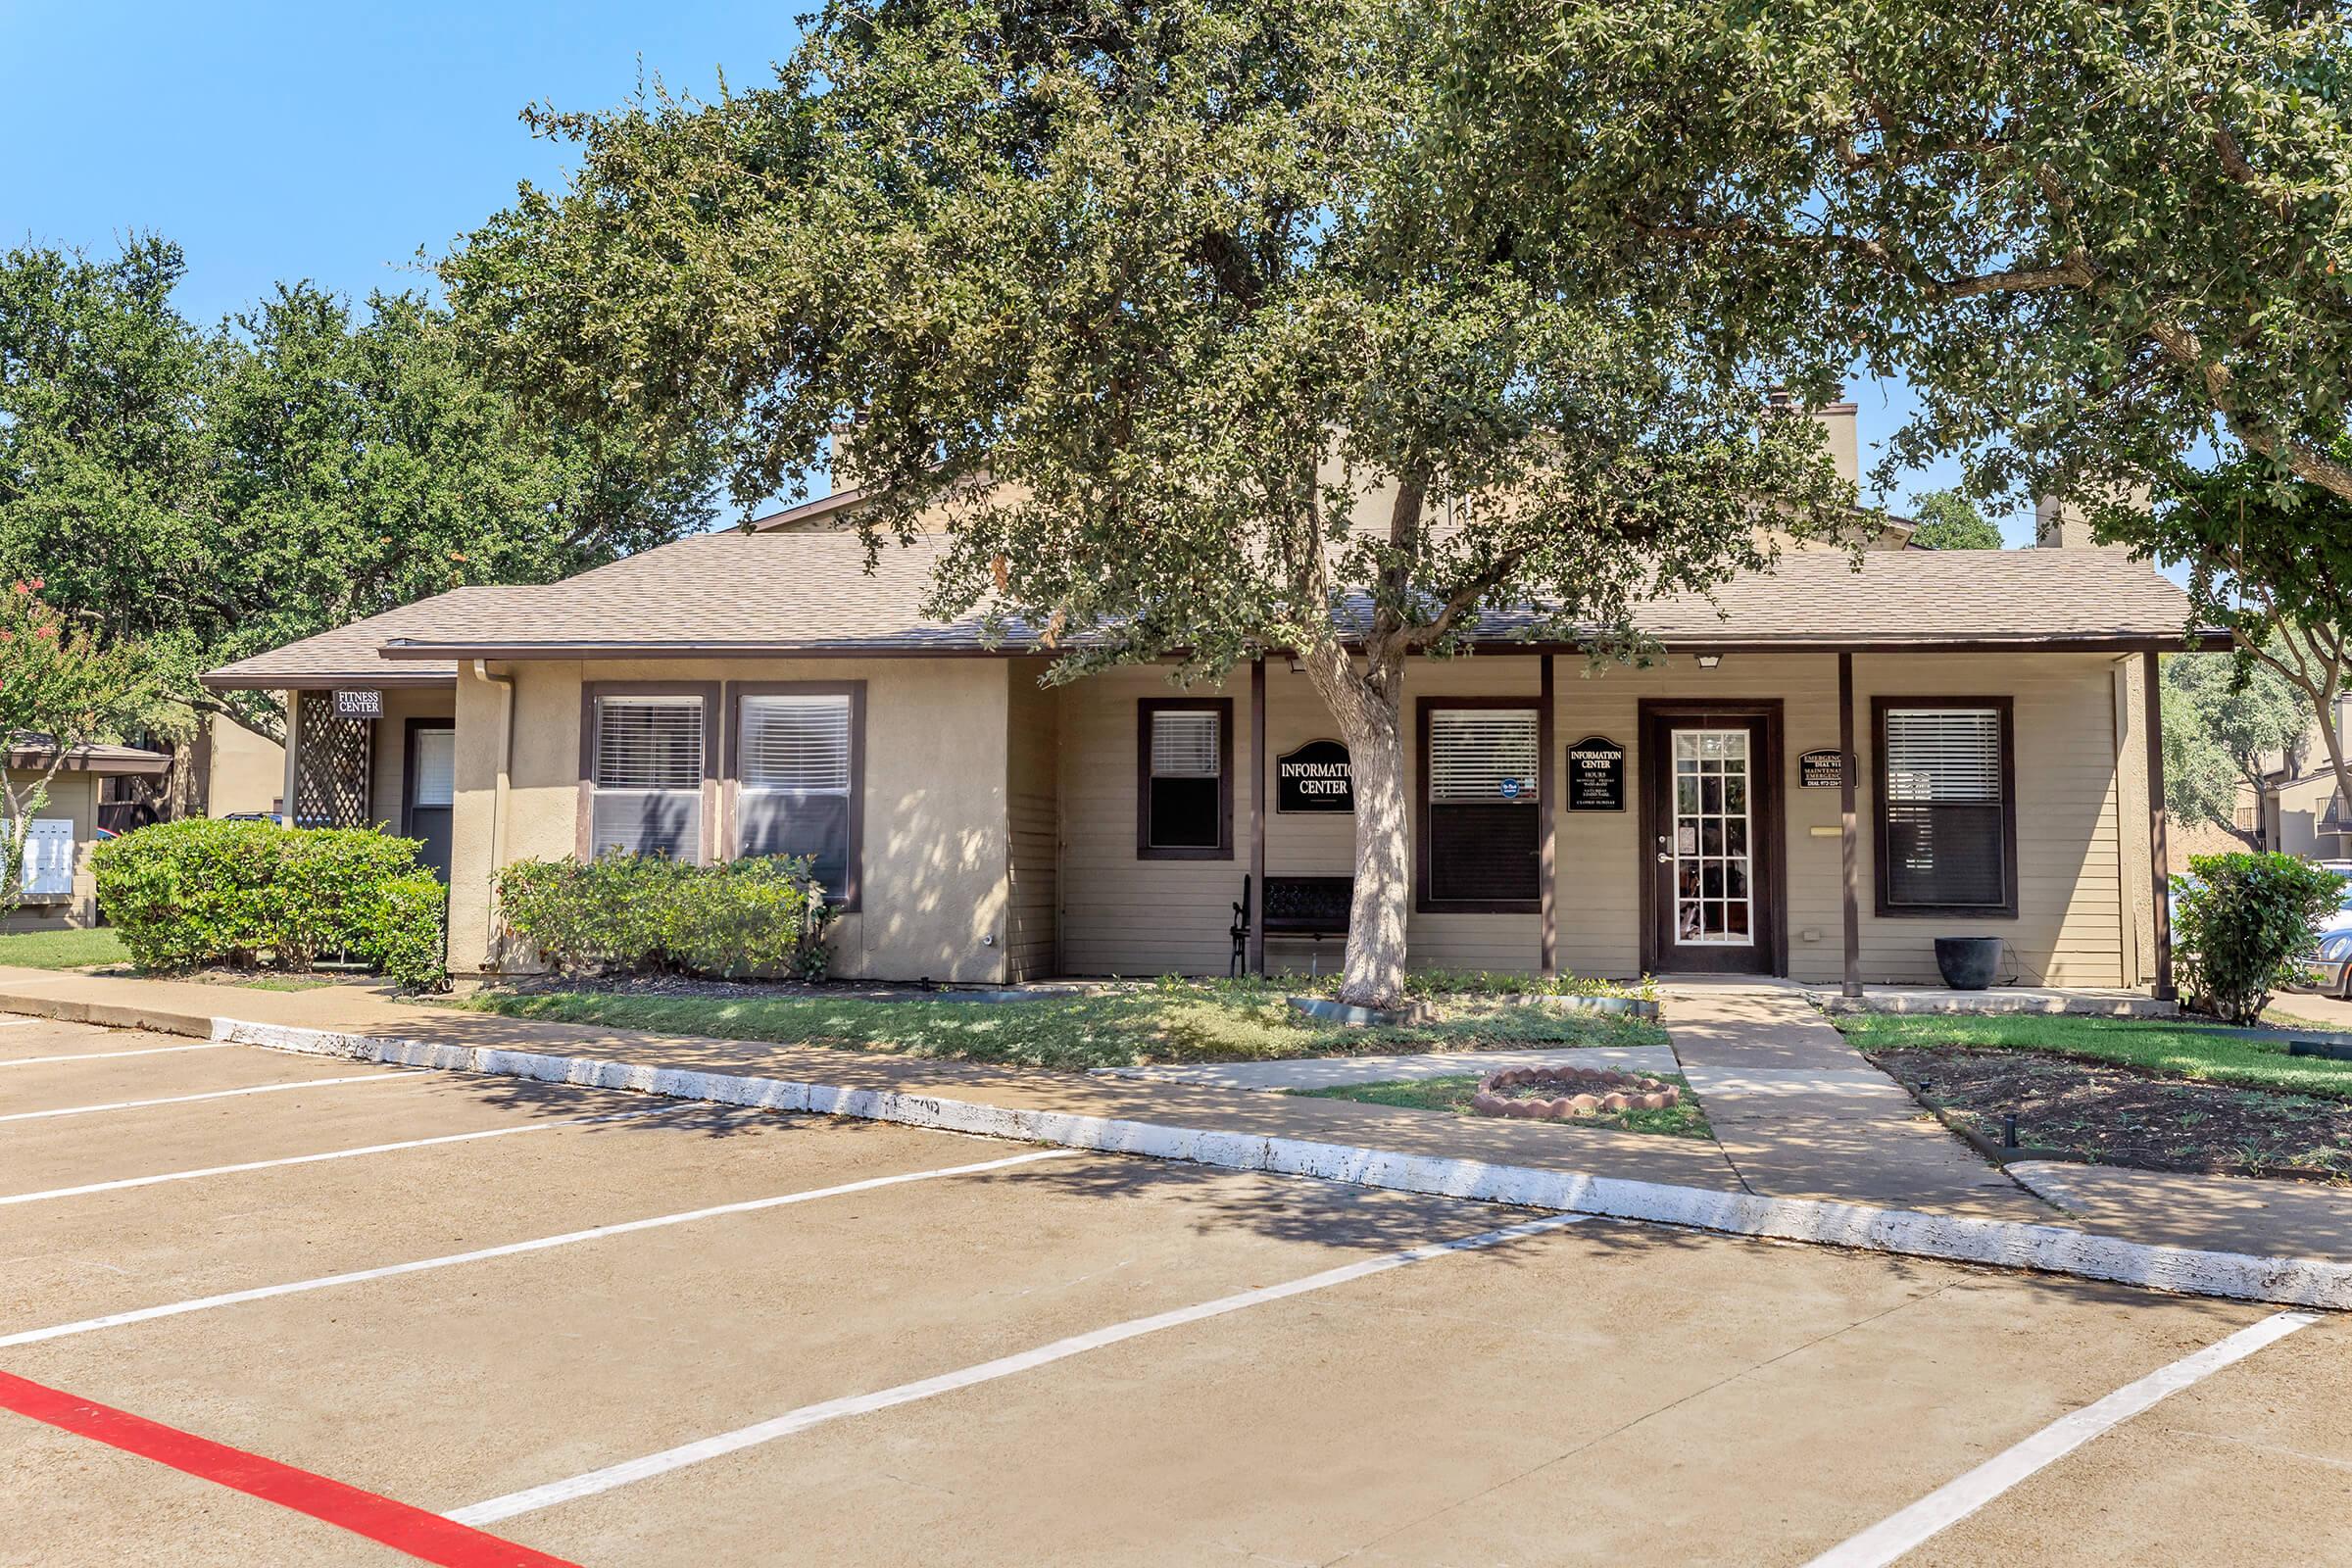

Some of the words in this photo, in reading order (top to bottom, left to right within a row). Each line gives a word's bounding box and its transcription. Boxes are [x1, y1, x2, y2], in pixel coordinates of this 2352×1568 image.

[338, 691, 378, 703] FITNESS
[339, 702, 379, 712] CENTER
[1571, 751, 1622, 760] INFORMATION
[1281, 763, 1352, 777] INFORMATI
[1581, 760, 1611, 769] CENTER
[1299, 780, 1348, 794] CENTER
